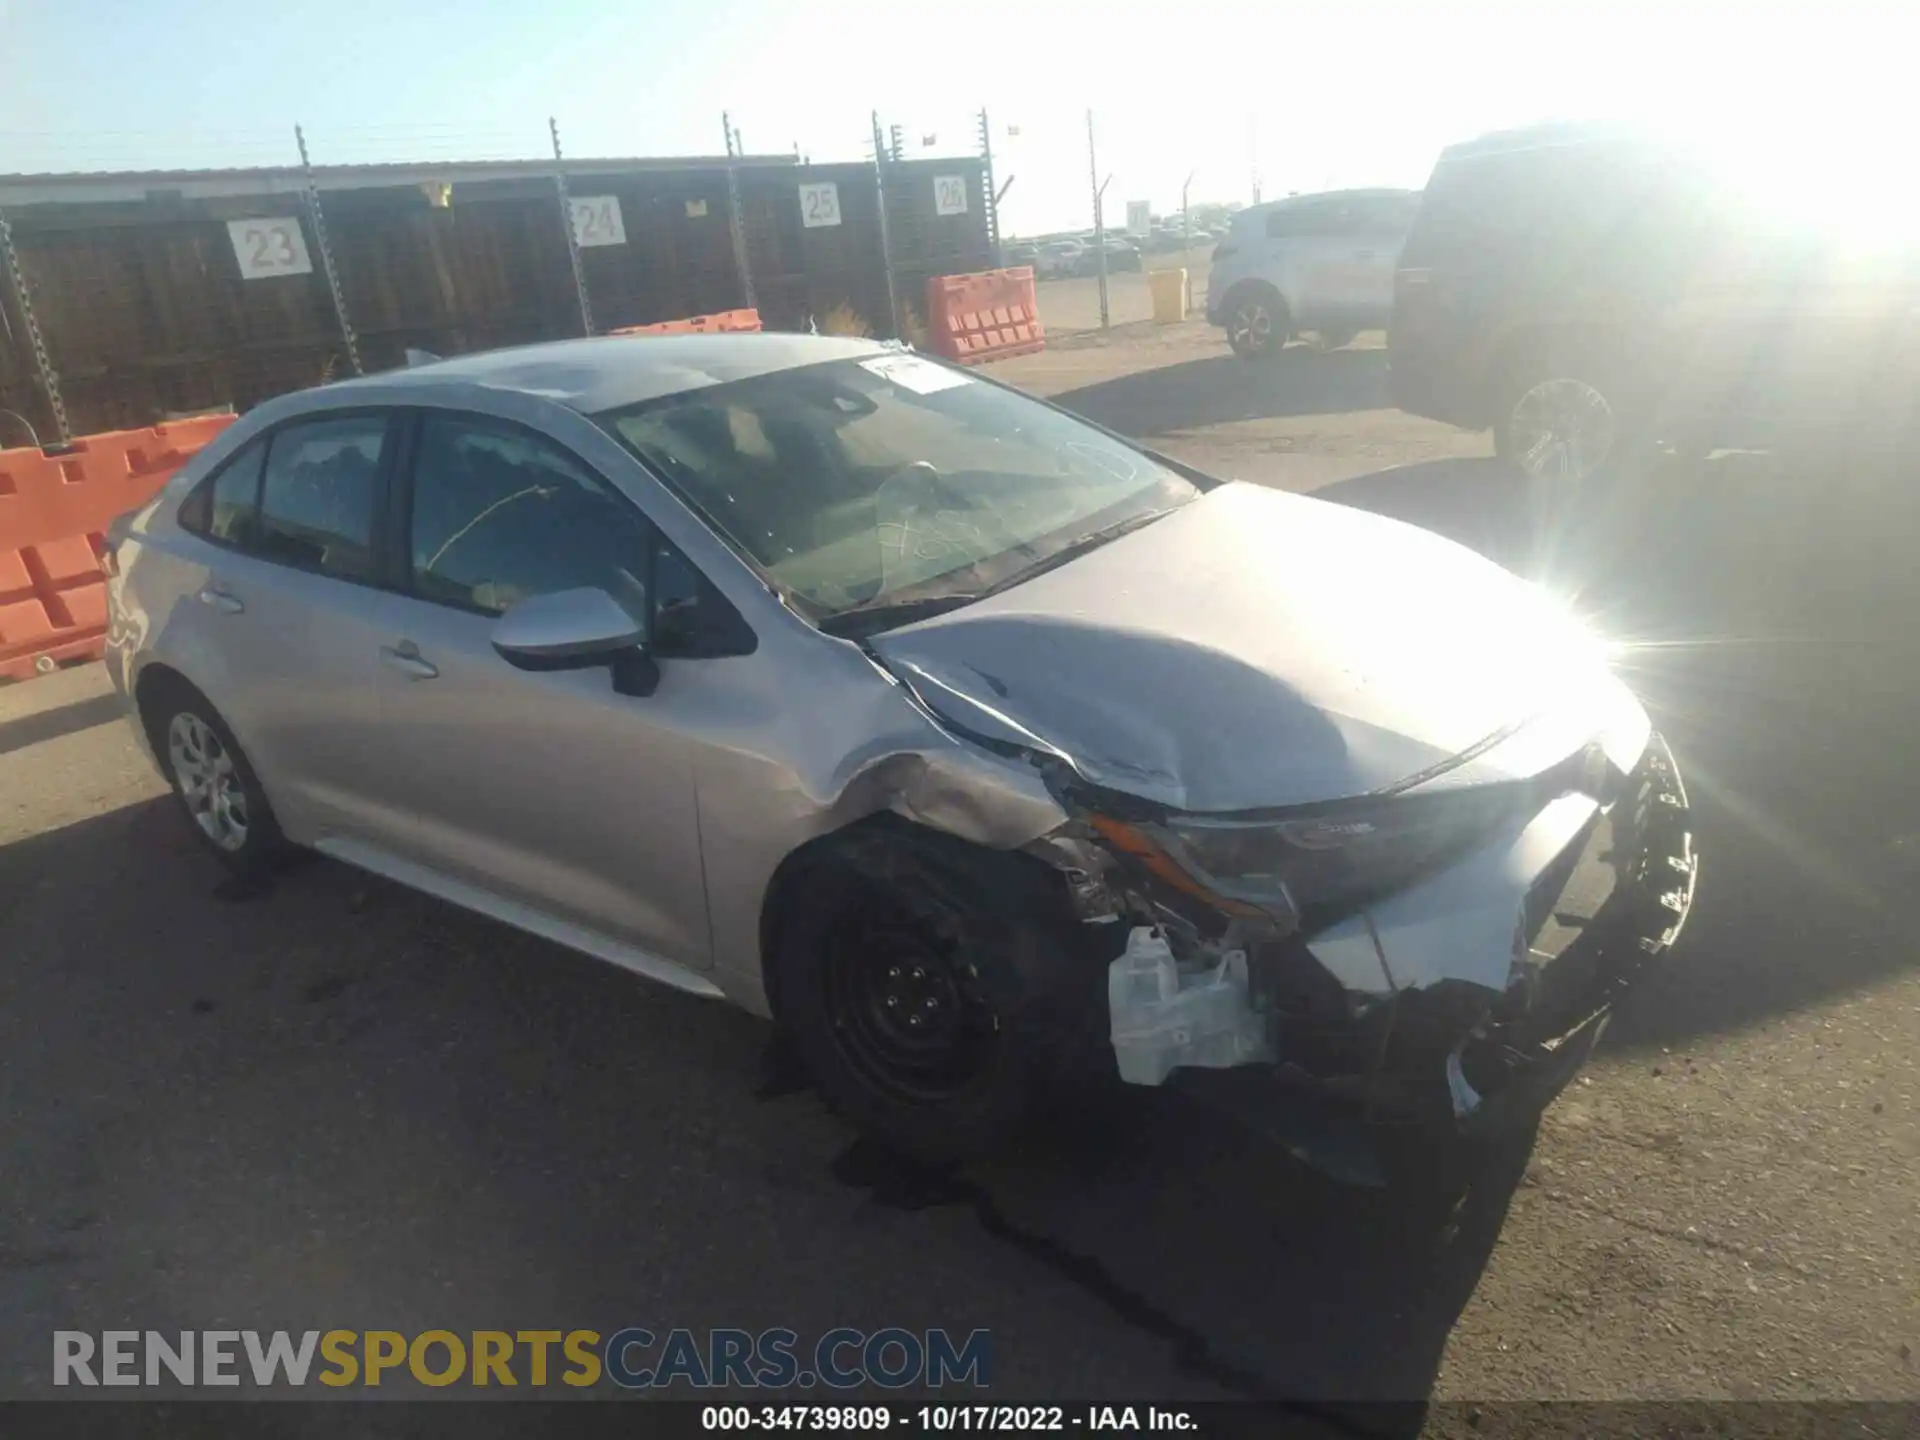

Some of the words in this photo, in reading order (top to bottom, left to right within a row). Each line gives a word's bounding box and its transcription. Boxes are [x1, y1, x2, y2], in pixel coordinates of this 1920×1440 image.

[807, 188, 835, 220] 25
[941, 179, 963, 211] 26
[578, 203, 616, 240] 24
[246, 225, 297, 269] 23
